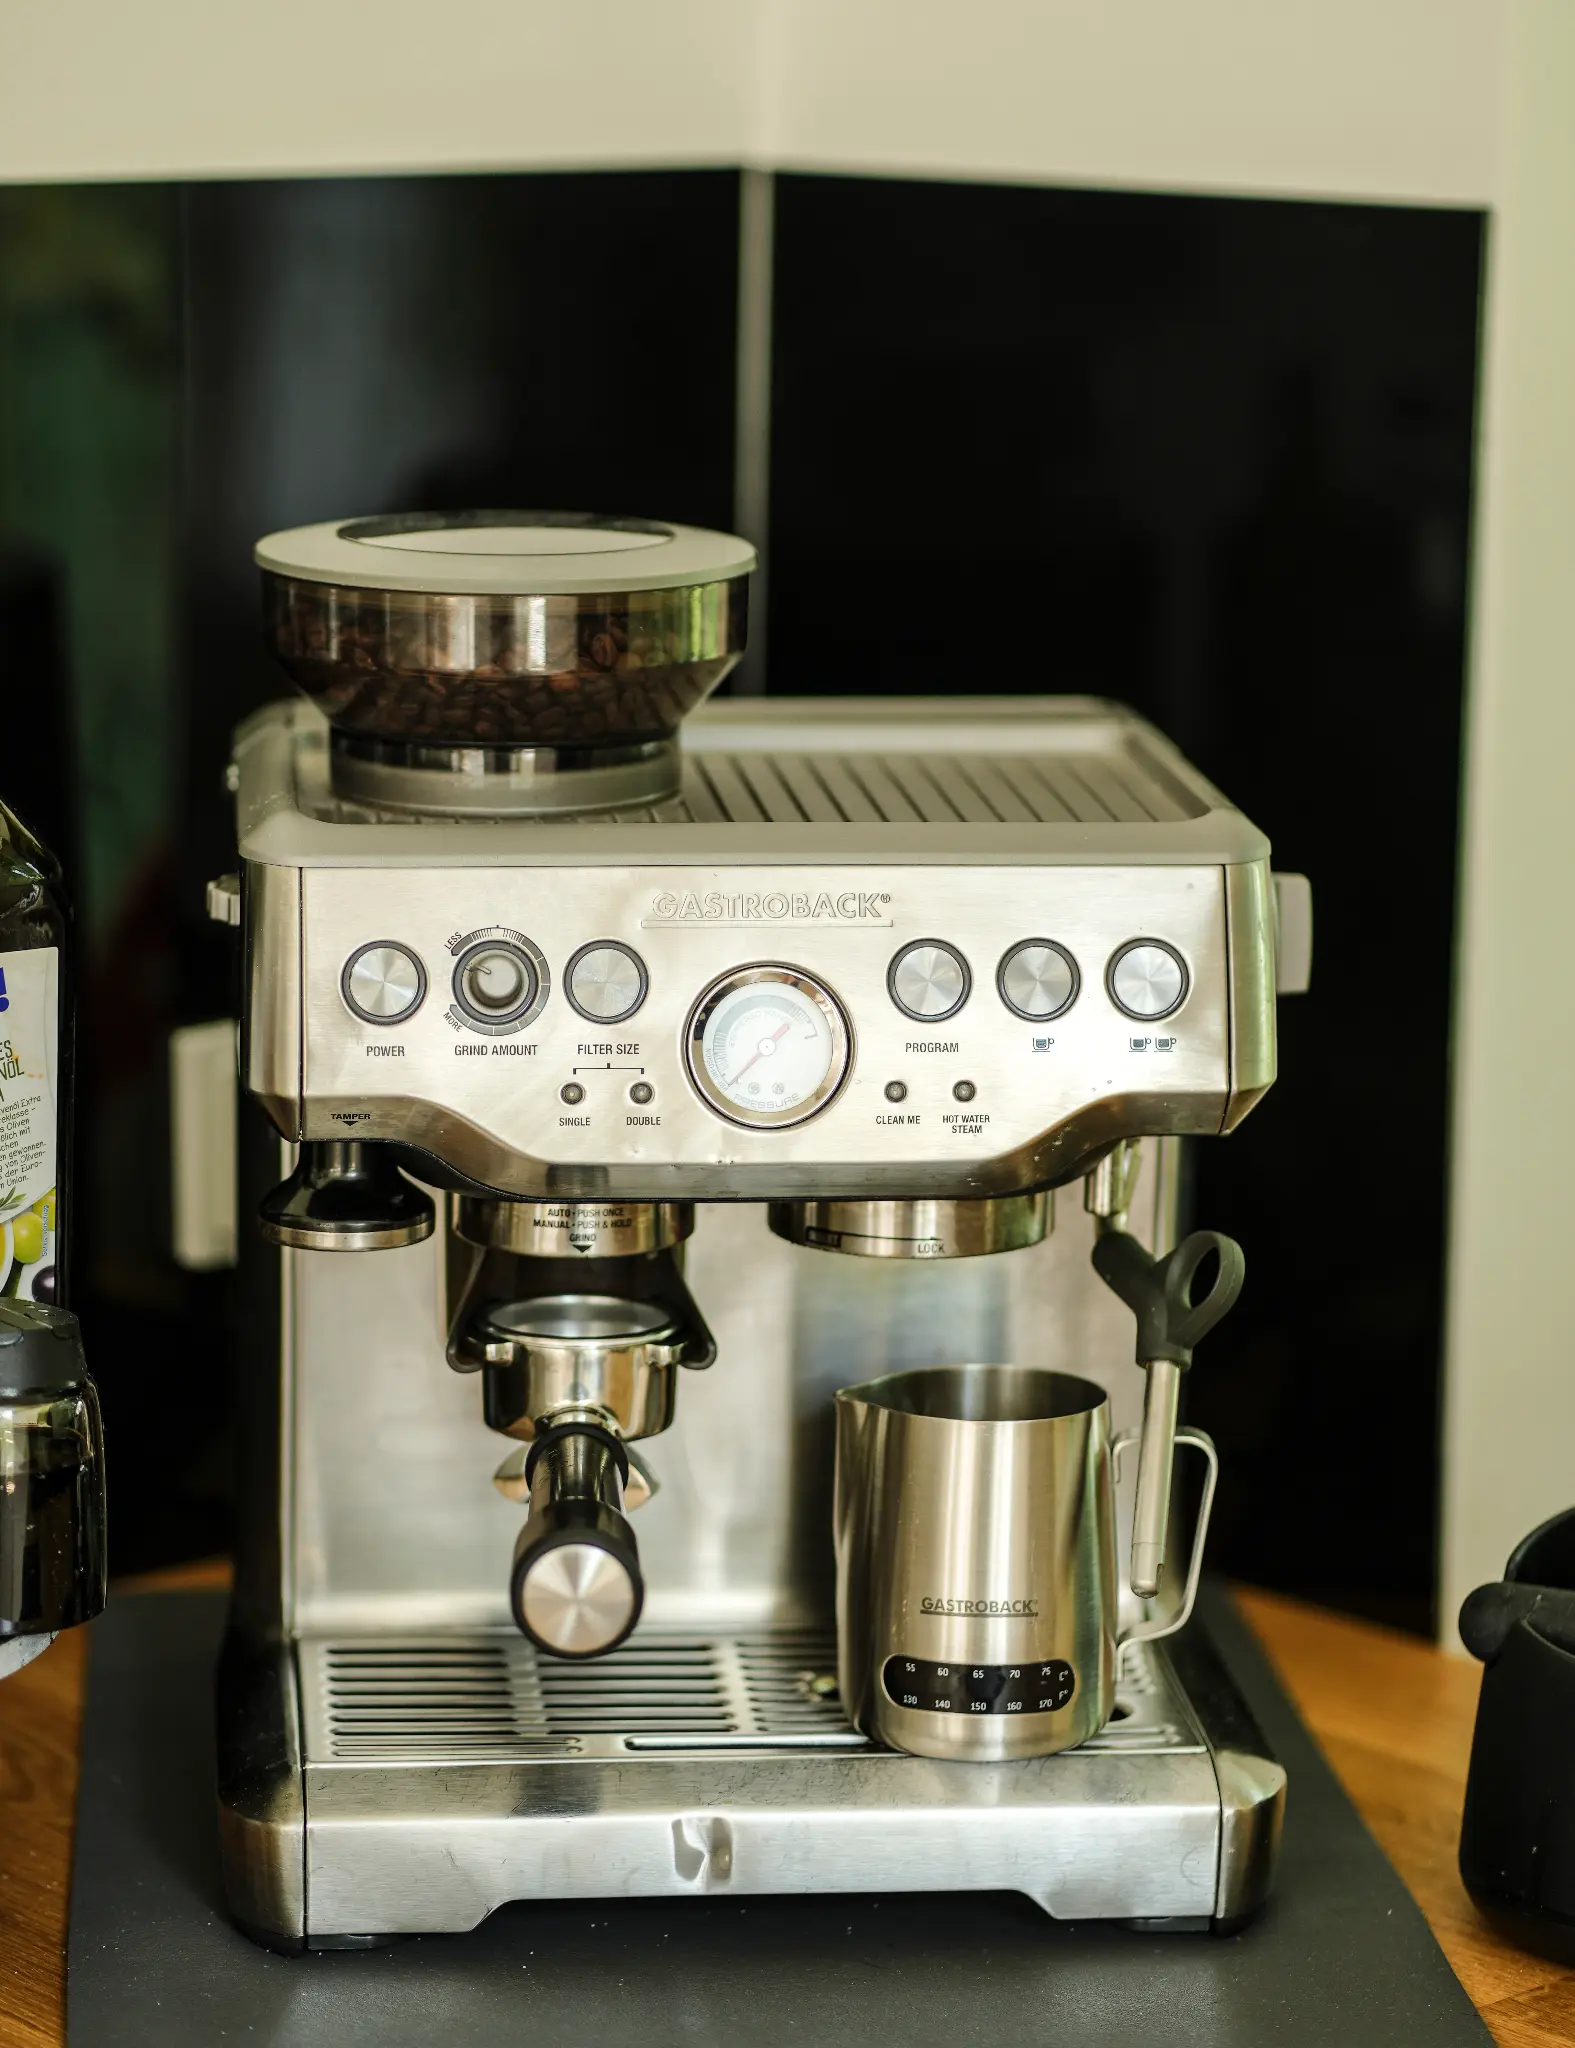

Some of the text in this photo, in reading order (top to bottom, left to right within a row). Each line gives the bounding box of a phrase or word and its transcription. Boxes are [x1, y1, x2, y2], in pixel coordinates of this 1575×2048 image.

[444, 931, 463, 950] LESS
[443, 1012, 463, 1033] MORE
[366, 1045, 405, 1057] POWER
[454, 1044, 539, 1056] GRIND AMOUNT
[577, 1043, 640, 1055] FILTER SIZE
[905, 1042, 959, 1054] PROGRAM
[21, 1095, 41, 1107] Extra
[733, 1092, 801, 1109] PRESSURE
[7, 1118, 30, 1131] Oliven
[559, 1116, 591, 1127] SINGLE
[626, 1116, 661, 1127] DOUBLE
[876, 1115, 921, 1125] CLEAN ME
[942, 1114, 990, 1124] HOT WATER
[20, 1126, 31, 1136] mit
[951, 1124, 983, 1134] STEAM
[5, 1159, 18, 1168] von
[5, 1168, 18, 1178] der
[21, 1161, 43, 1173] Euro-
[547, 1208, 625, 1217] AUTO PUSH ONCE
[533, 1218, 632, 1229] MANUAL PUSH & HOLD
[569, 1233, 596, 1242] GRIND
[917, 1243, 945, 1254] LOCK
[905, 1662, 916, 1673] 55
[937, 1667, 949, 1678] 60
[972, 1669, 984, 1679] 65
[1009, 1669, 1021, 1679] 70
[1041, 1667, 1051, 1676] 75
[903, 1694, 918, 1705] 130
[934, 1699, 950, 1709] 140
[970, 1701, 987, 1711] 150
[1006, 1701, 1022, 1711] 160
[1039, 1698, 1053, 1709] 170
